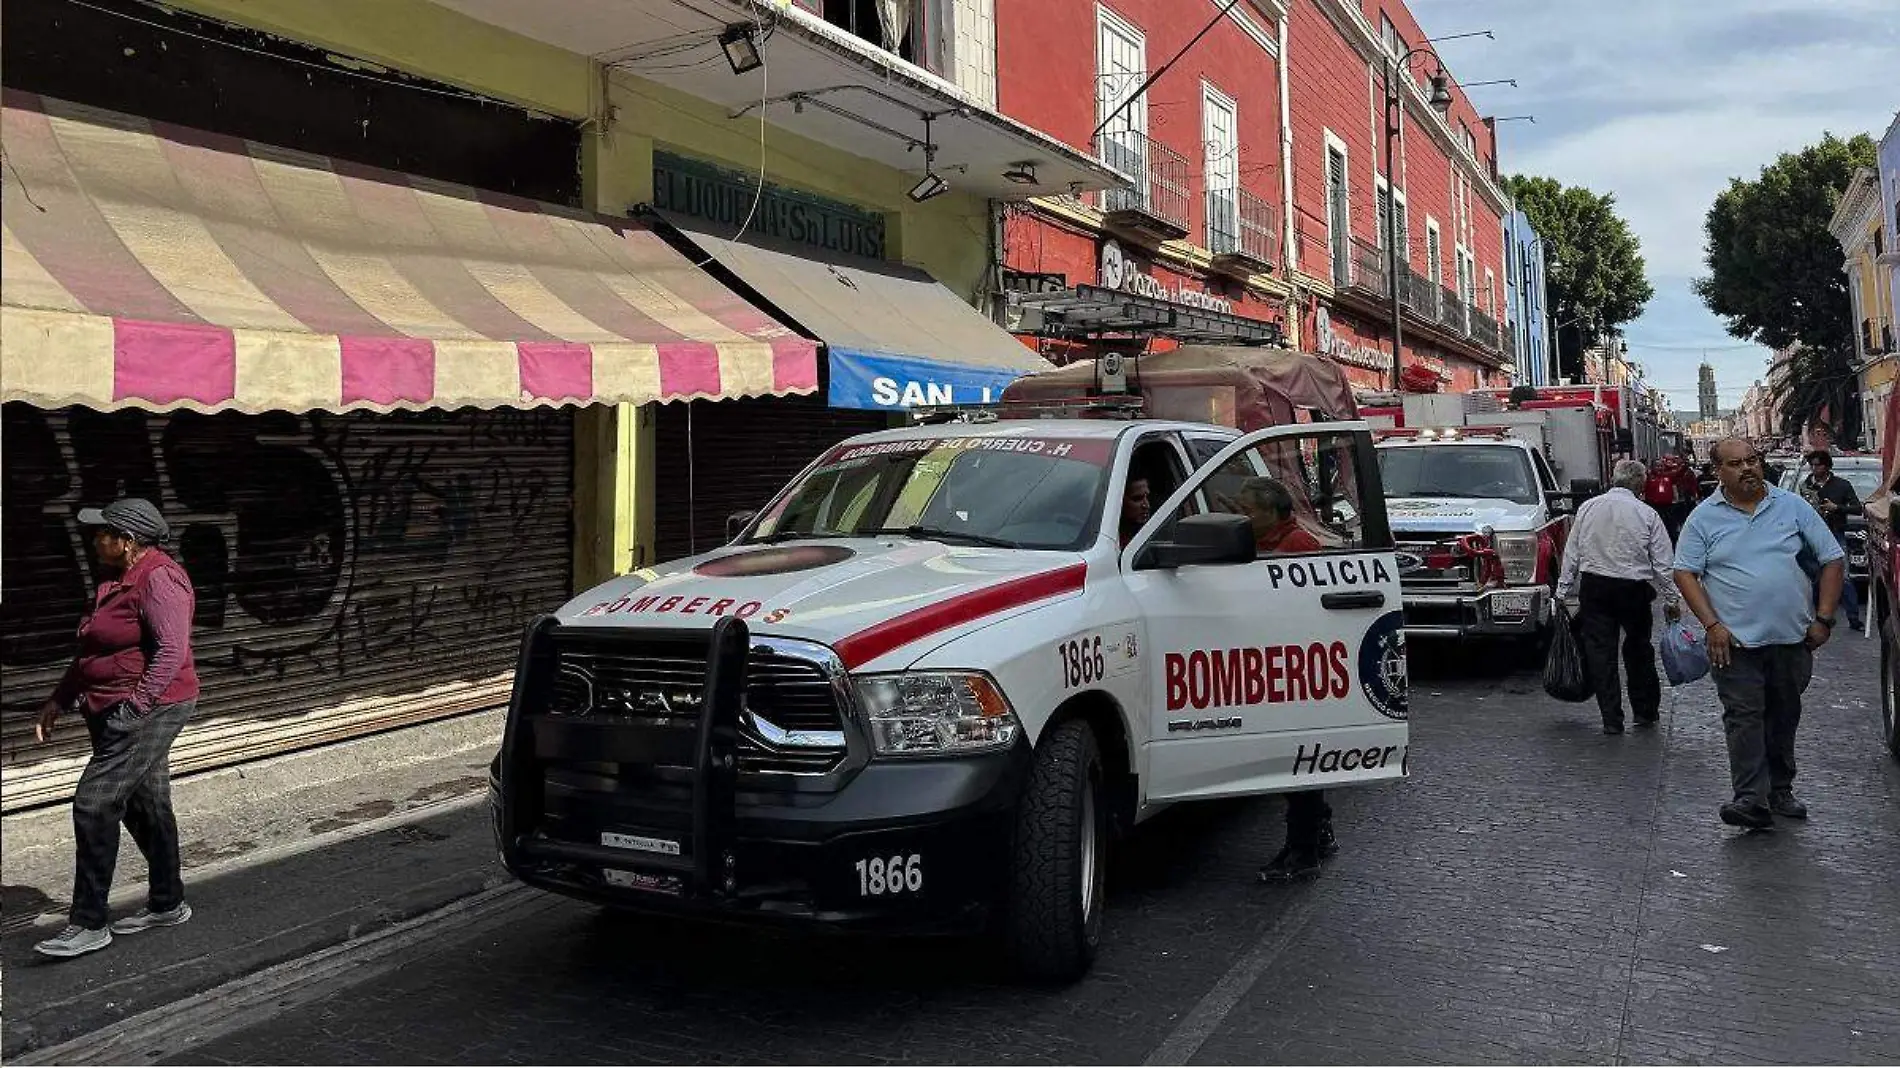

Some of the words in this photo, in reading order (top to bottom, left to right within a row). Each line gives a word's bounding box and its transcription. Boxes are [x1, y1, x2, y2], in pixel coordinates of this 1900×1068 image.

[872, 377, 953, 406] SAN
[1267, 558, 1391, 589] POLICIA
[1058, 635, 1105, 689] 1866
[1165, 640, 1350, 712] BOMBEROS
[1292, 743, 1397, 776] Hacer
[855, 854, 923, 896] 1866
